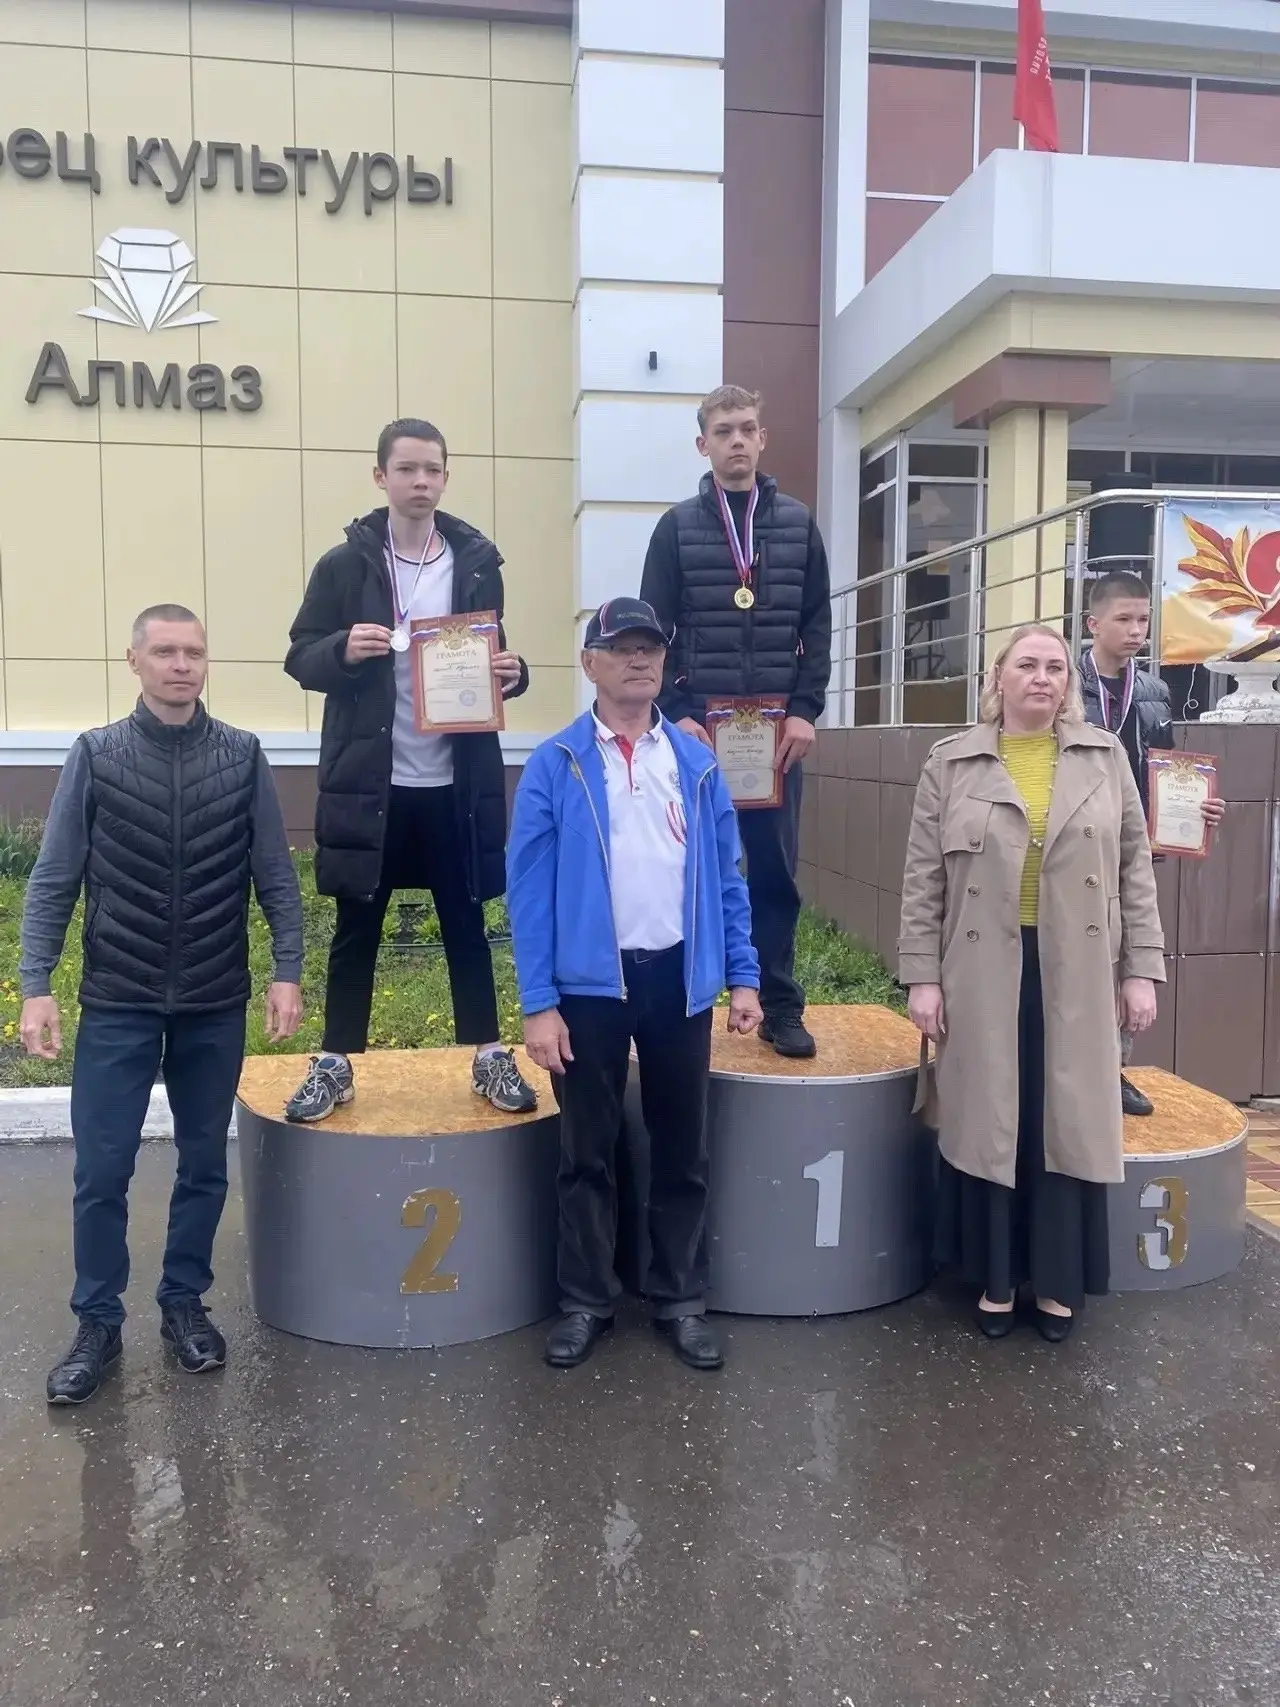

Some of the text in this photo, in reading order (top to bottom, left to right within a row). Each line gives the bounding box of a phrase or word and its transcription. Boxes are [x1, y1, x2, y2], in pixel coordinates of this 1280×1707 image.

[0, 128, 454, 216] ец культуры
[25, 341, 263, 412] Алмаз
[400, 1187, 461, 1294] 2
[803, 1150, 844, 1247] 1
[1138, 1176, 1189, 1270] 3
